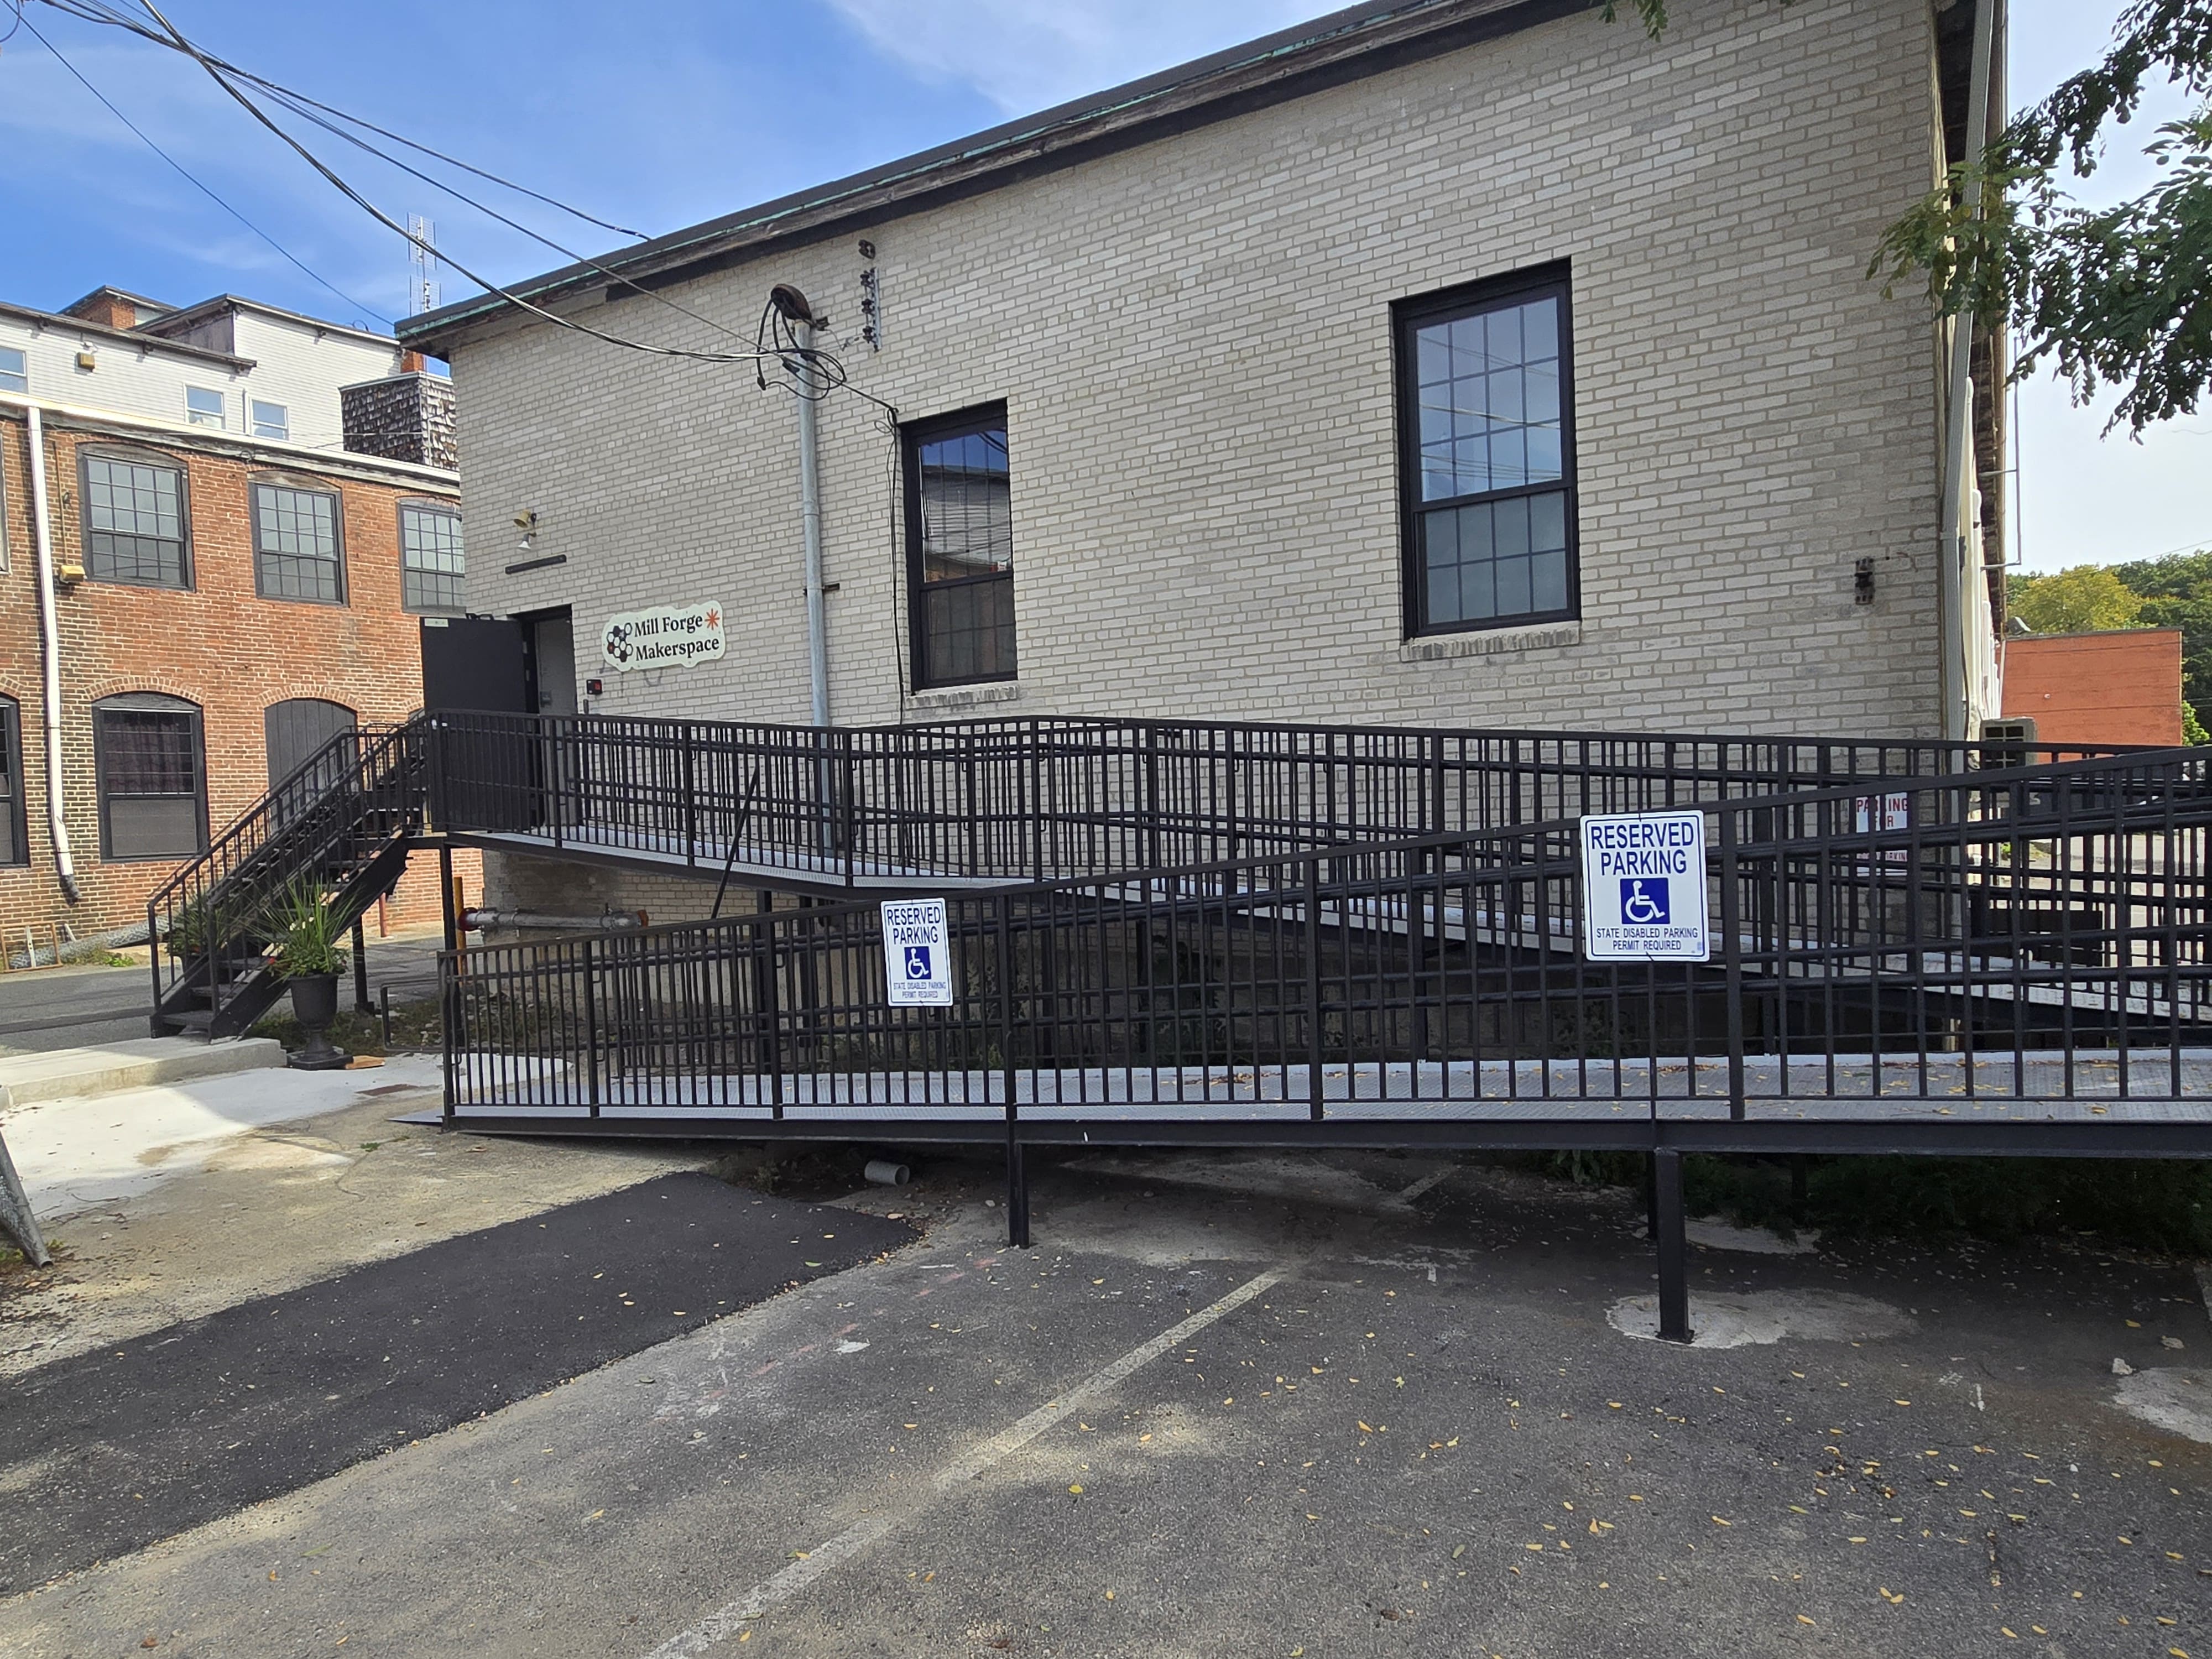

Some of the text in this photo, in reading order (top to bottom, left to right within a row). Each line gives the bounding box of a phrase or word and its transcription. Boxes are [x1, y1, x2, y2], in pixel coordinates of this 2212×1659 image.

[634, 615, 703, 637] Mill Forge
[635, 638, 719, 661] Makerspace
[1857, 798, 1907, 812] PAING
[1591, 822, 1694, 849] RESERVED
[1601, 849, 1687, 875] PARKING
[886, 906, 941, 926] RESERVED
[893, 926, 938, 945] PARKING
[1597, 927, 1698, 938] STATE DISABLED PARKING
[1613, 940, 1681, 950] PERMIT REQUIRED
